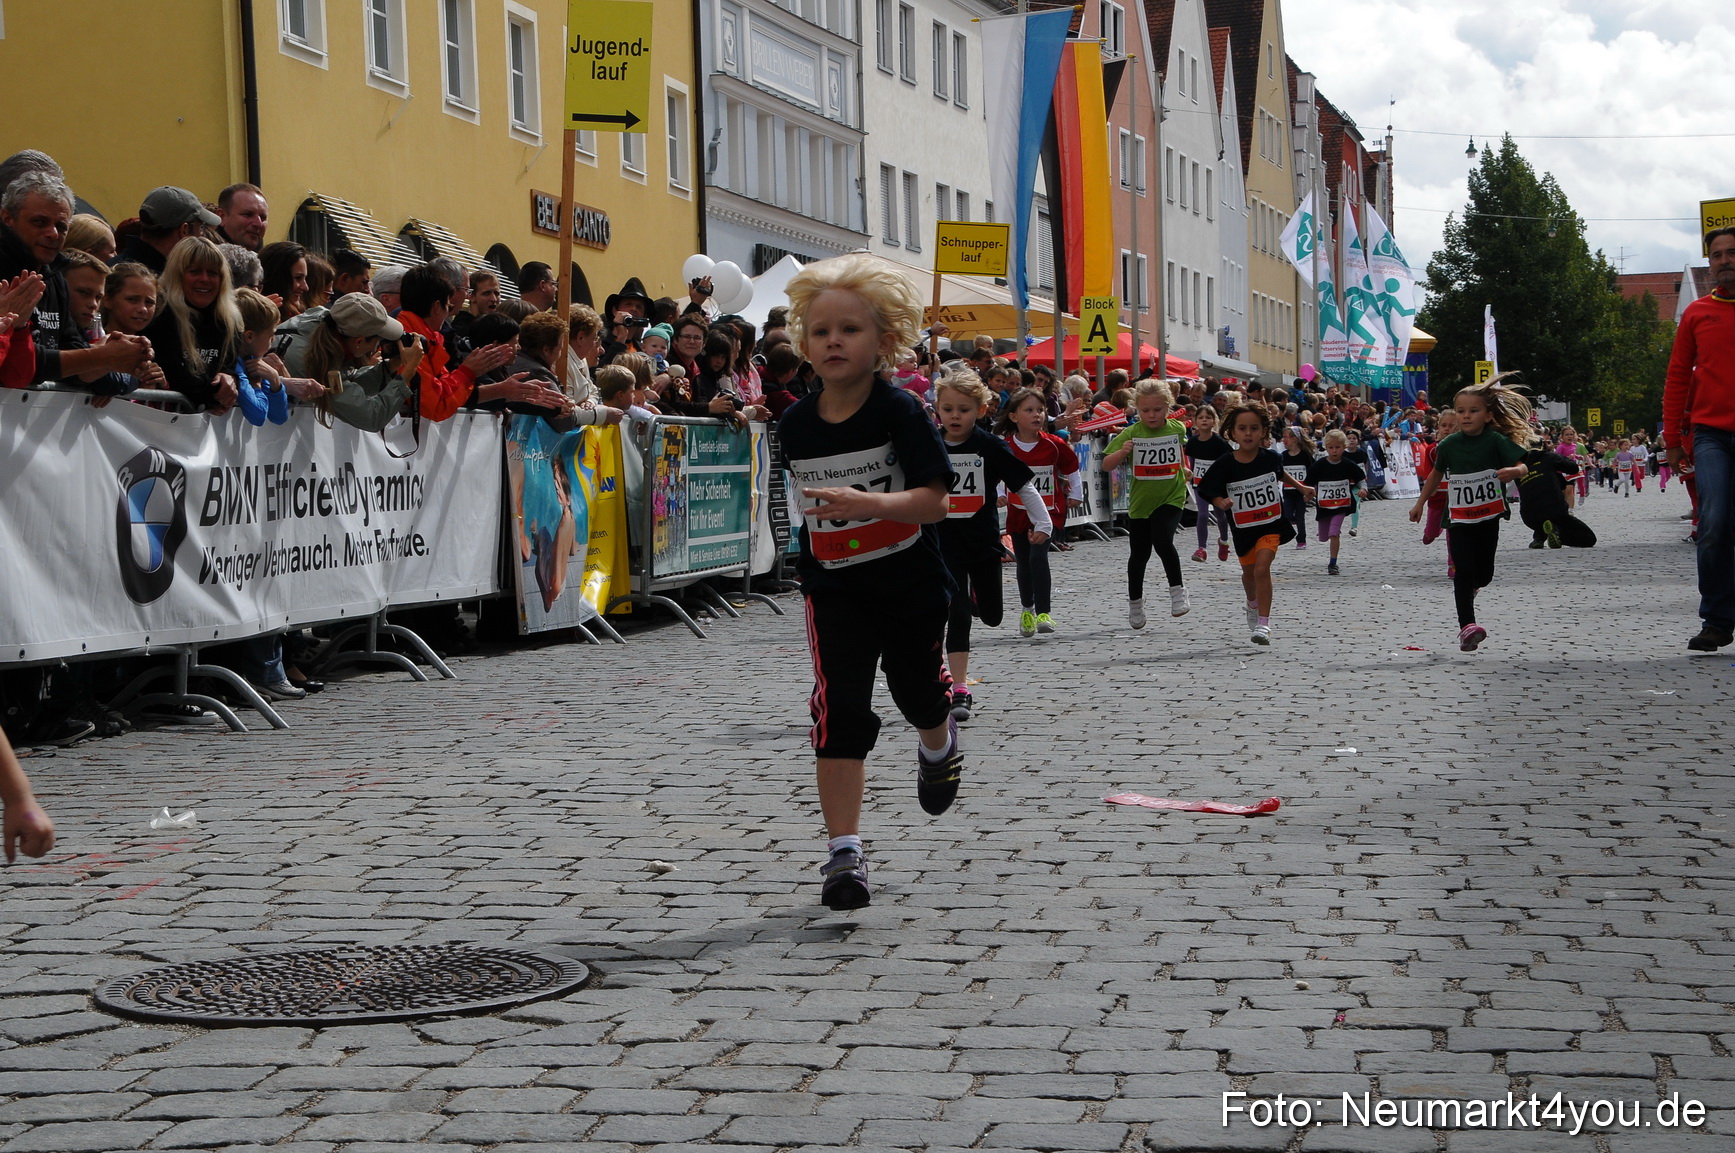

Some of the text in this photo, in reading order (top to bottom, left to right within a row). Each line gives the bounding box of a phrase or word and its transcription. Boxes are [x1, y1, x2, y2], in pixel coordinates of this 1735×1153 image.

[570, 34, 649, 60] Jugend-
[592, 61, 628, 81] lauf
[753, 39, 815, 91] BRILLEN WEBER
[941, 236, 1004, 251] Schnupper-
[961, 252, 982, 263] lauf
[1084, 298, 1115, 310] Block
[1087, 313, 1110, 343] A
[1590, 413, 1598, 423] C
[1616, 423, 1622, 432] D
[1138, 447, 1176, 465] 7203
[1151, 440, 1173, 452] Neumarkt
[118, 450, 185, 500] BMW
[824, 460, 881, 480] Neumarkt
[1464, 475, 1491, 485] Neumarkt
[690, 480, 705, 501] Mehr
[950, 471, 977, 495] 24
[1033, 477, 1050, 493] 44
[1453, 481, 1497, 505] 7048
[199, 462, 424, 527] BMW EfficientDynamics
[1234, 485, 1276, 510] 7056
[1322, 487, 1348, 500] 7393
[199, 544, 262, 592] Weniger
[264, 534, 338, 579] Verbrauch.
